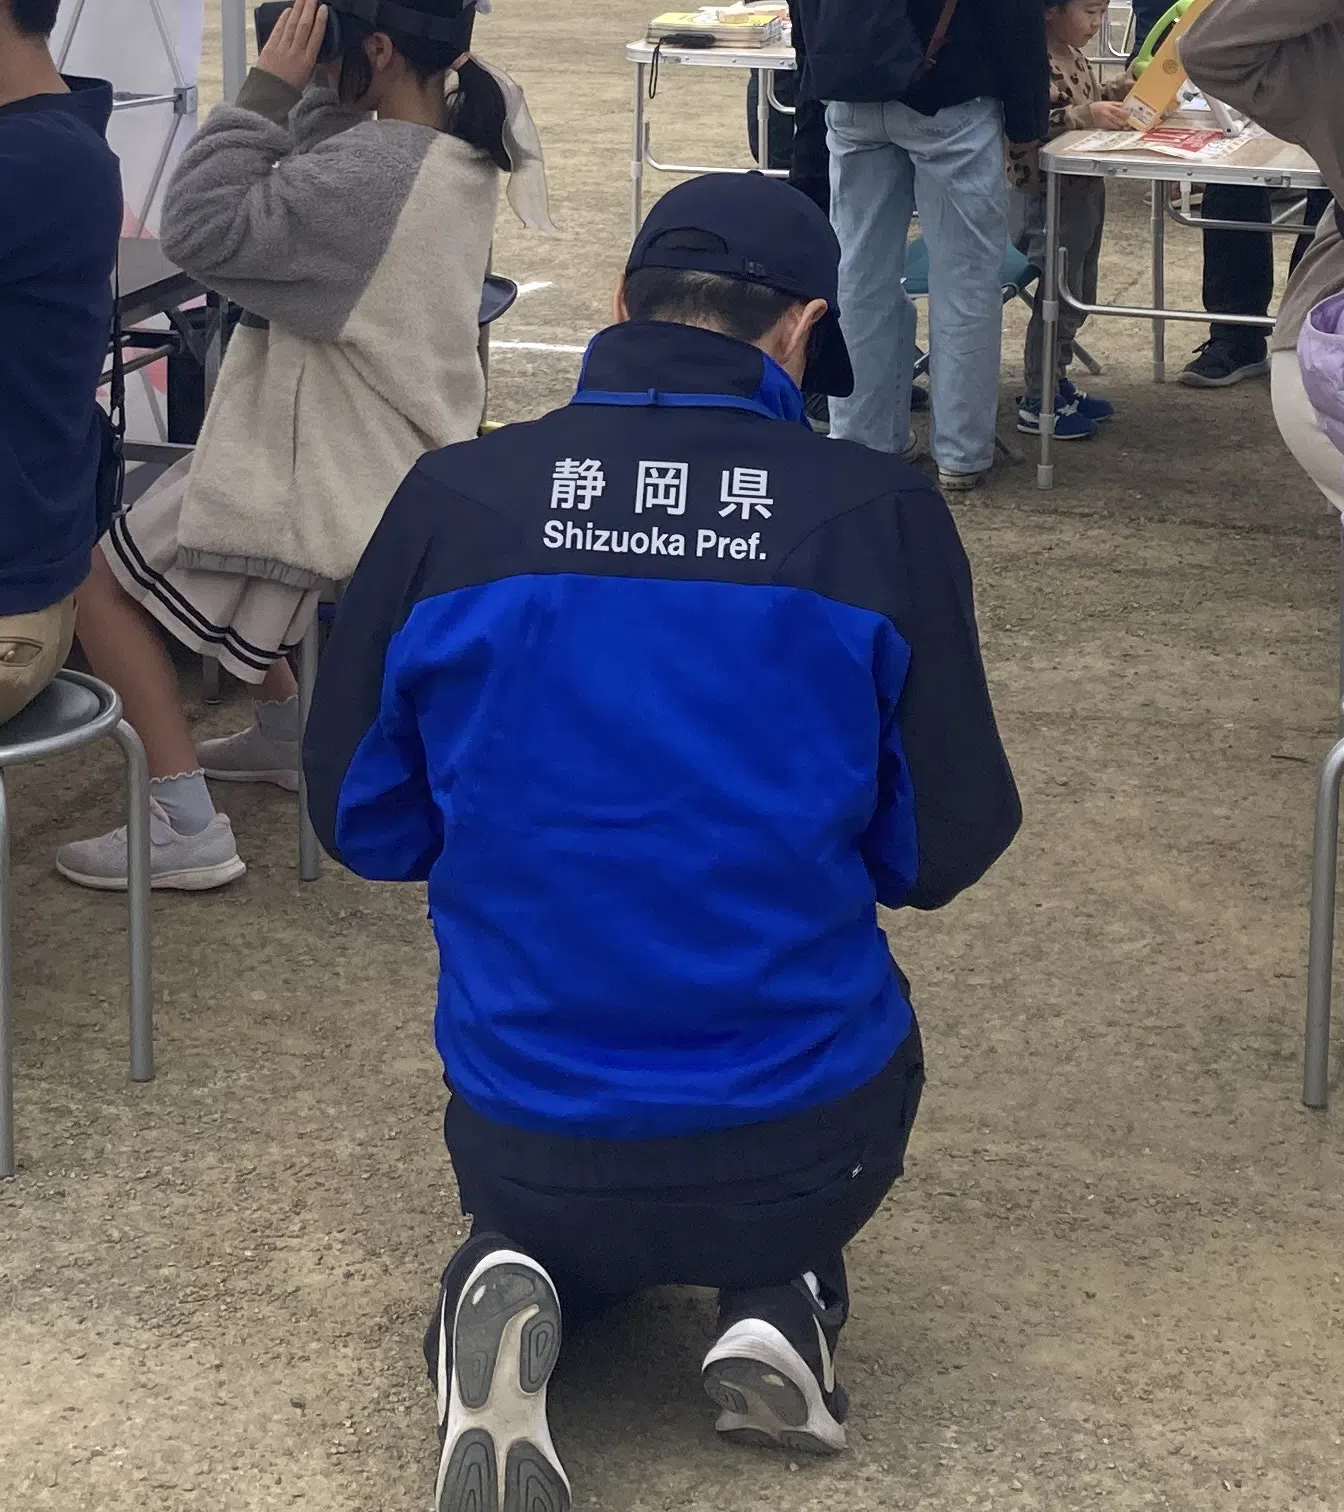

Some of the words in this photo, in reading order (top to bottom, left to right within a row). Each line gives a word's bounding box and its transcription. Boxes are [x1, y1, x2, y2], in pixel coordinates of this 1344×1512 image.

[549, 457, 775, 521] 静岡県
[542, 519, 686, 557] Shizuoka
[695, 528, 768, 561] Pref.
